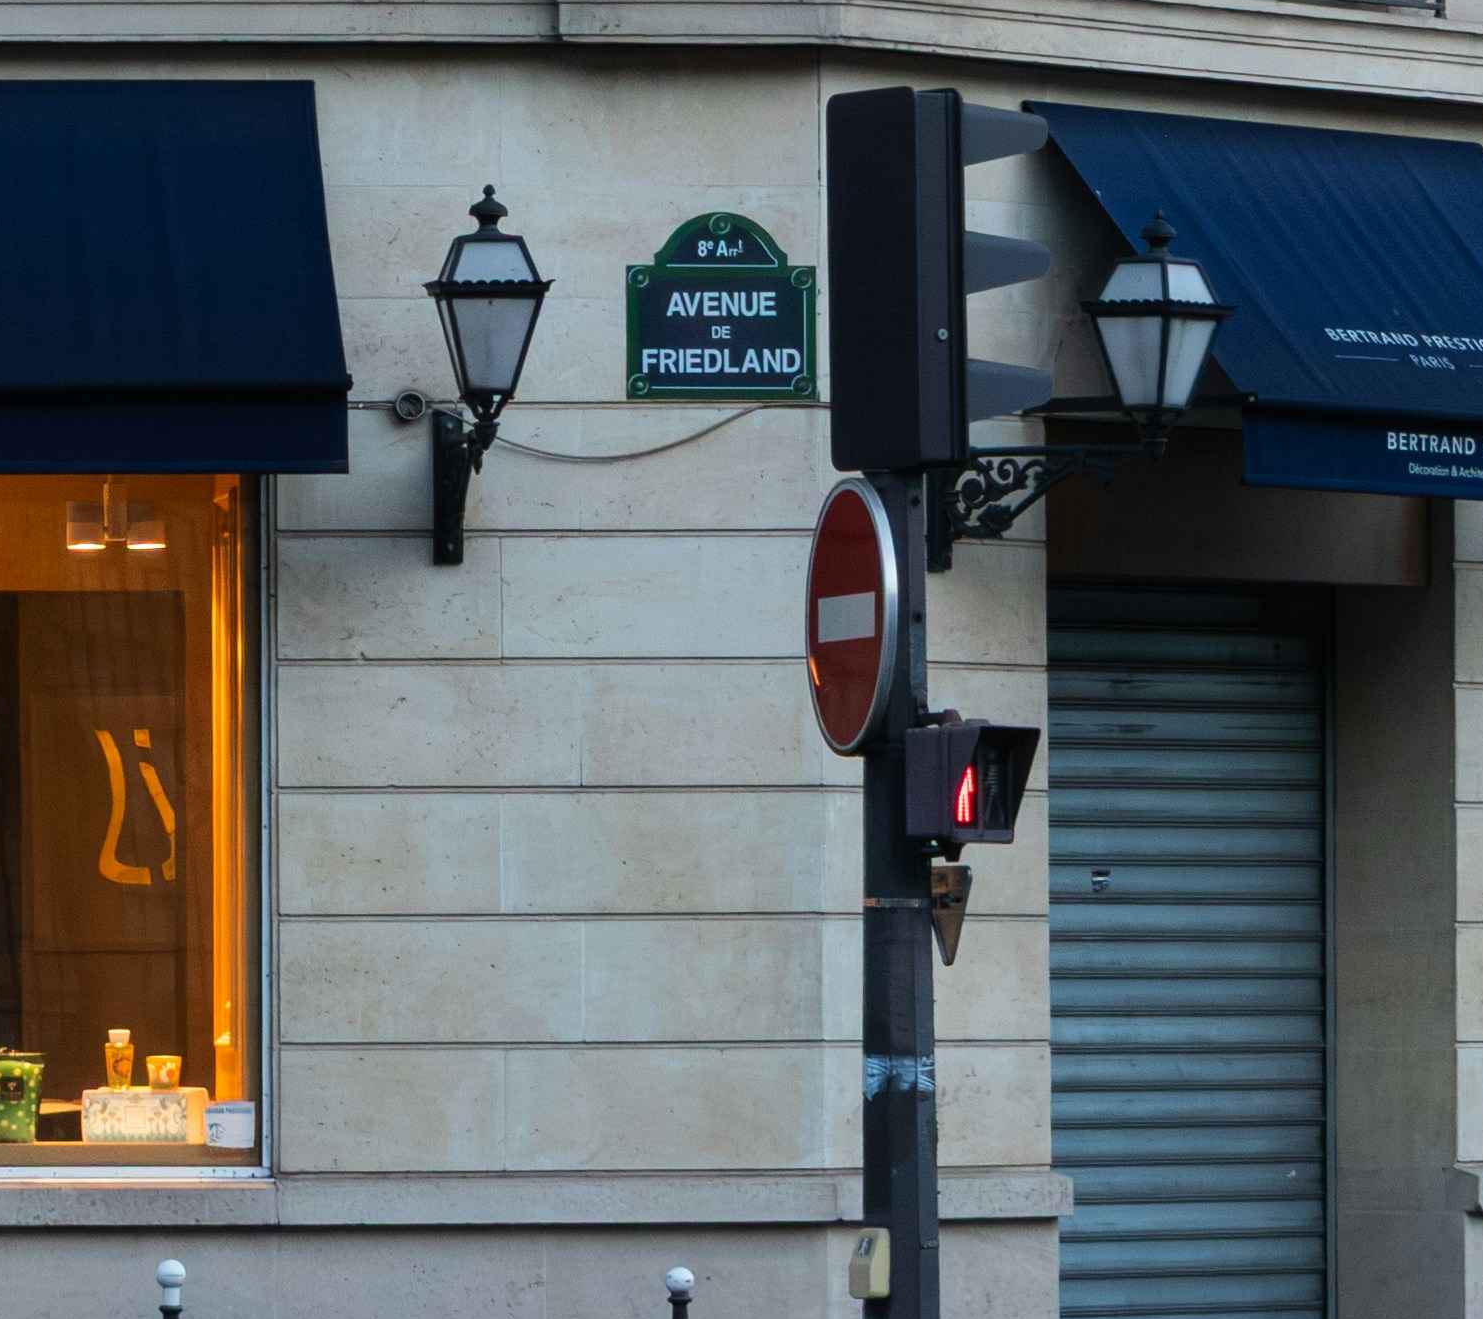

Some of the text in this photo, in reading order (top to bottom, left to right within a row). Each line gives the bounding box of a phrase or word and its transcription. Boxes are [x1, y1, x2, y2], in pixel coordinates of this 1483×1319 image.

[697, 240, 714, 257] 8e
[666, 291, 777, 317] AVENUE
[711, 325, 731, 339] DE
[1324, 327, 1419, 348] BERTRAND
[642, 348, 801, 374] FRIEDLAND
[1409, 353, 1456, 370] PARIS
[1386, 431, 1477, 456] BERTRAND
[1408, 462, 1449, 477] Décoration
[1451, 465, 1458, 477] &
